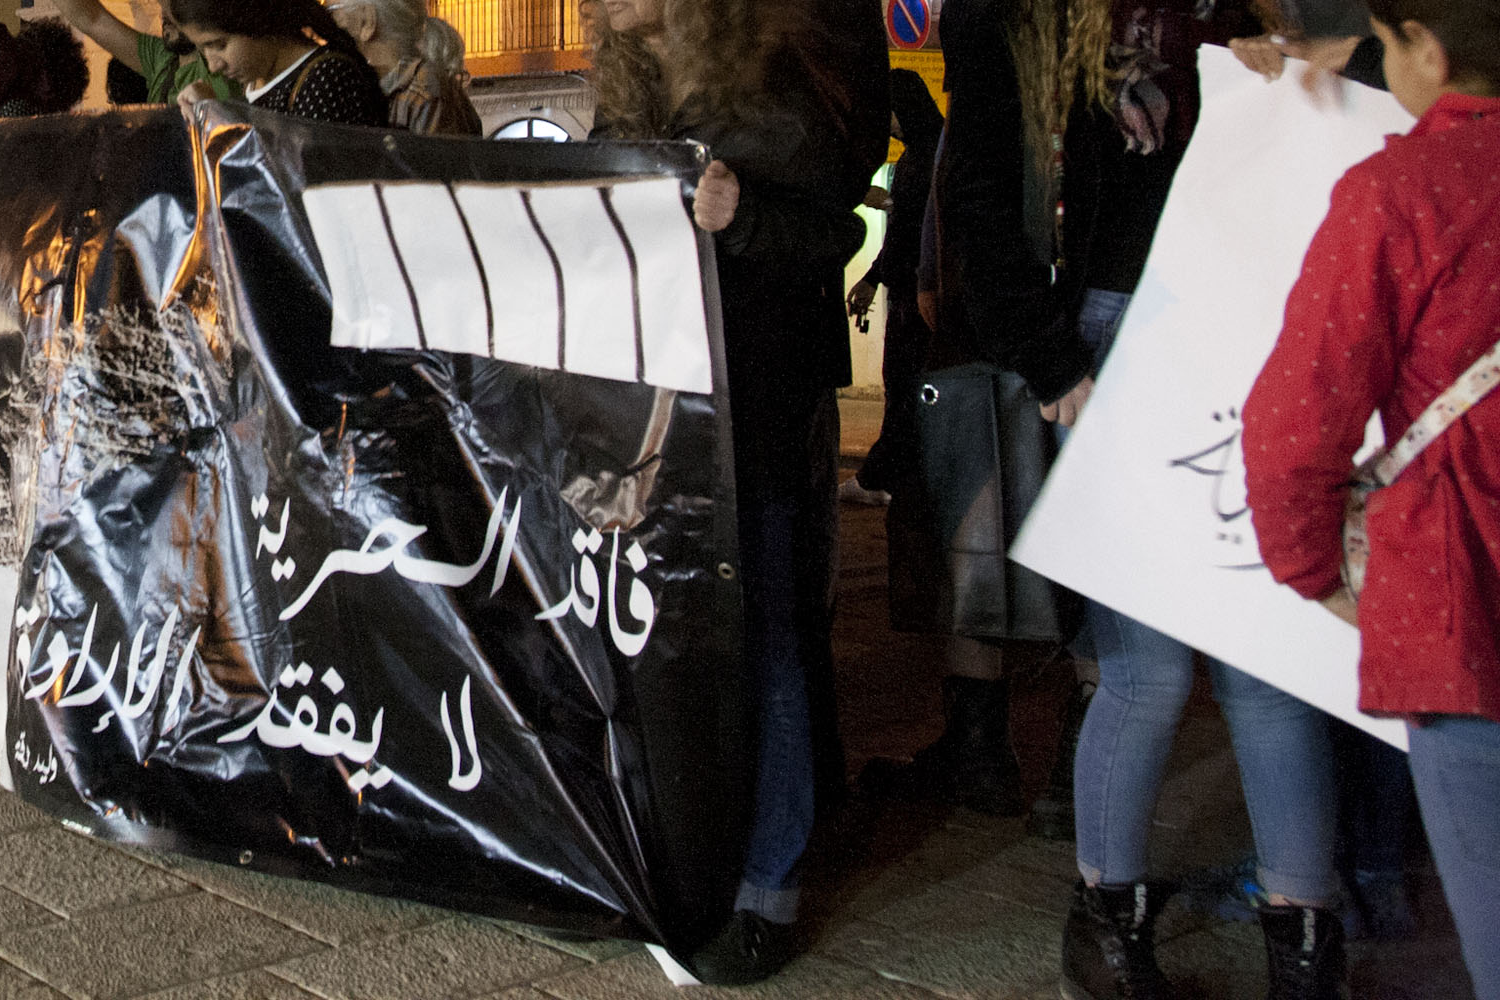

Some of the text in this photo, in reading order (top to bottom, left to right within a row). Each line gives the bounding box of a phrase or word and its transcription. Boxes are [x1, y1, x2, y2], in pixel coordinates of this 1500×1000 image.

[249, 484, 657, 658] فاقد الحرية
[15, 602, 483, 793] لا يفقد الإرادة
[32, 743, 59, 785] وليد
